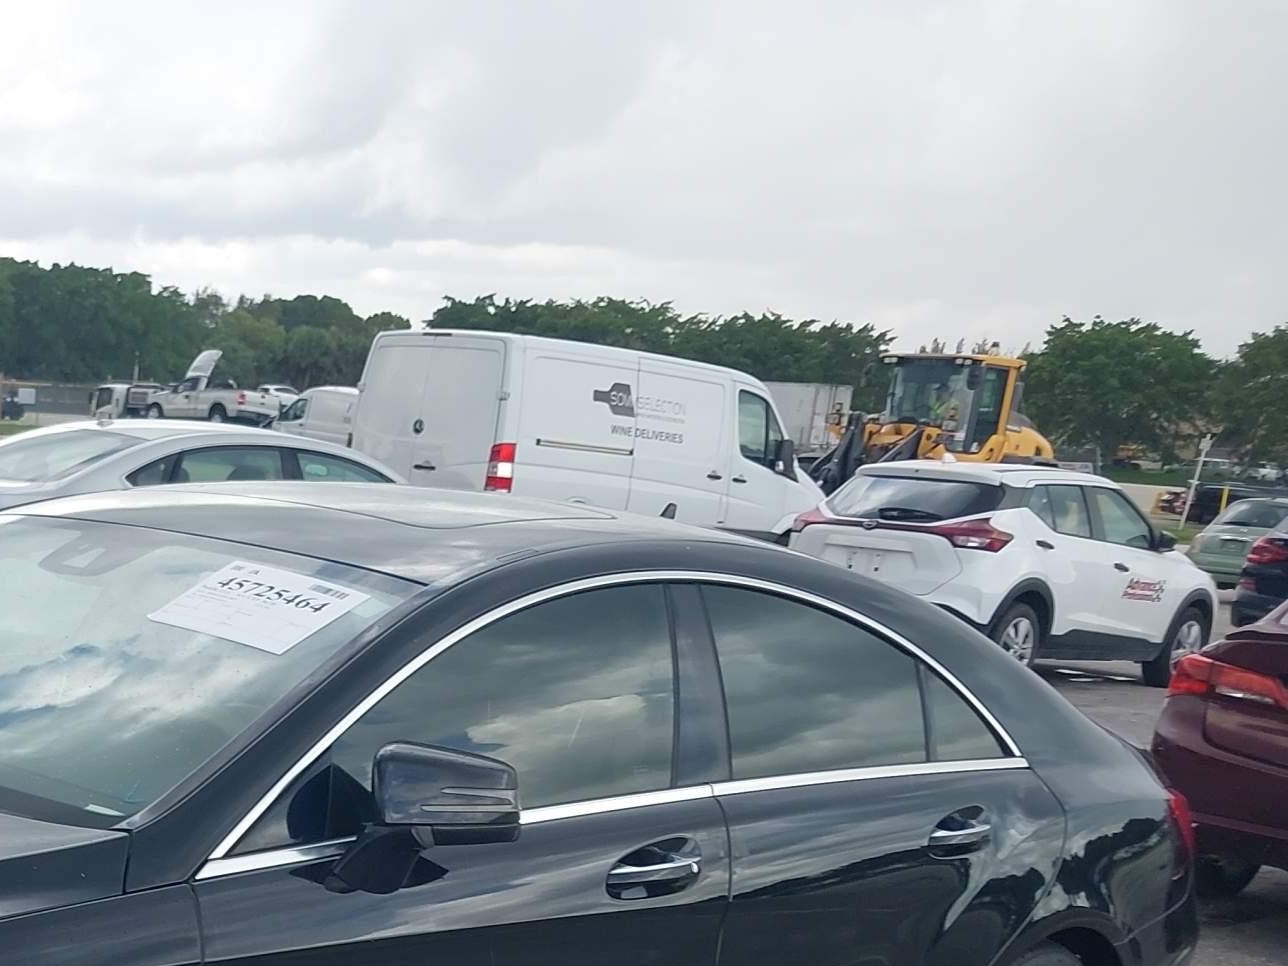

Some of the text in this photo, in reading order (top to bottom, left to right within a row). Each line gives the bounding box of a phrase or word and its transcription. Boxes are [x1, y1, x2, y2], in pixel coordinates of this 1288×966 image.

[610, 424, 684, 444] WINE DELIVERIES
[217, 576, 330, 614] 45725464
